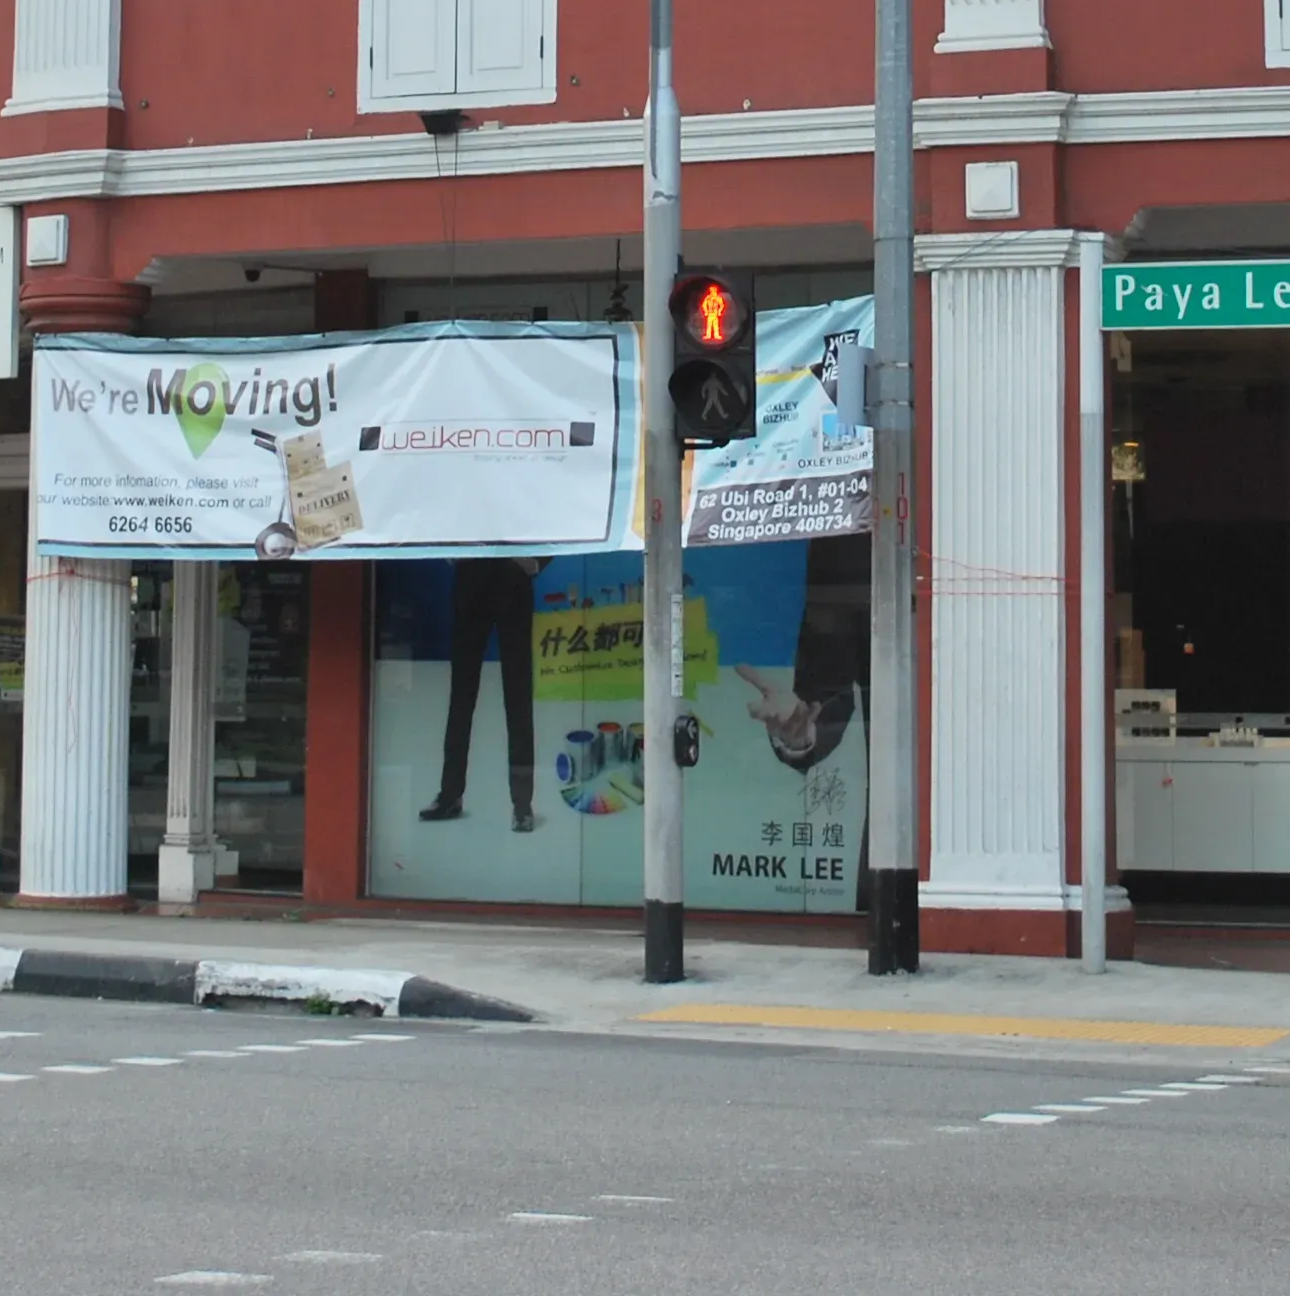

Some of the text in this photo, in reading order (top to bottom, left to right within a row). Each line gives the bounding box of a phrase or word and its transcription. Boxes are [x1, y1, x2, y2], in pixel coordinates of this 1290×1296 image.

[1115, 274, 1221, 320] Paya
[50, 362, 338, 427] We're Moving!
[380, 425, 566, 451] weiken.com
[797, 456, 833, 470] OXLEY
[54, 472, 77, 487] For
[80, 477, 110, 488] more
[185, 475, 230, 491] please
[232, 475, 260, 489] visit
[699, 476, 868, 510] 62 Ubi Road 1, #01-04
[113, 492, 230, 509] www.weiken.com
[233, 498, 246, 509] or
[248, 493, 272, 509] call
[721, 498, 845, 524] Oxley Bizhub 2
[108, 515, 193, 534] 6264 6656
[707, 512, 853, 542] Singapore 408734
[761, 819, 845, 848] 李国煌
[712, 853, 844, 881] MARK LEE
